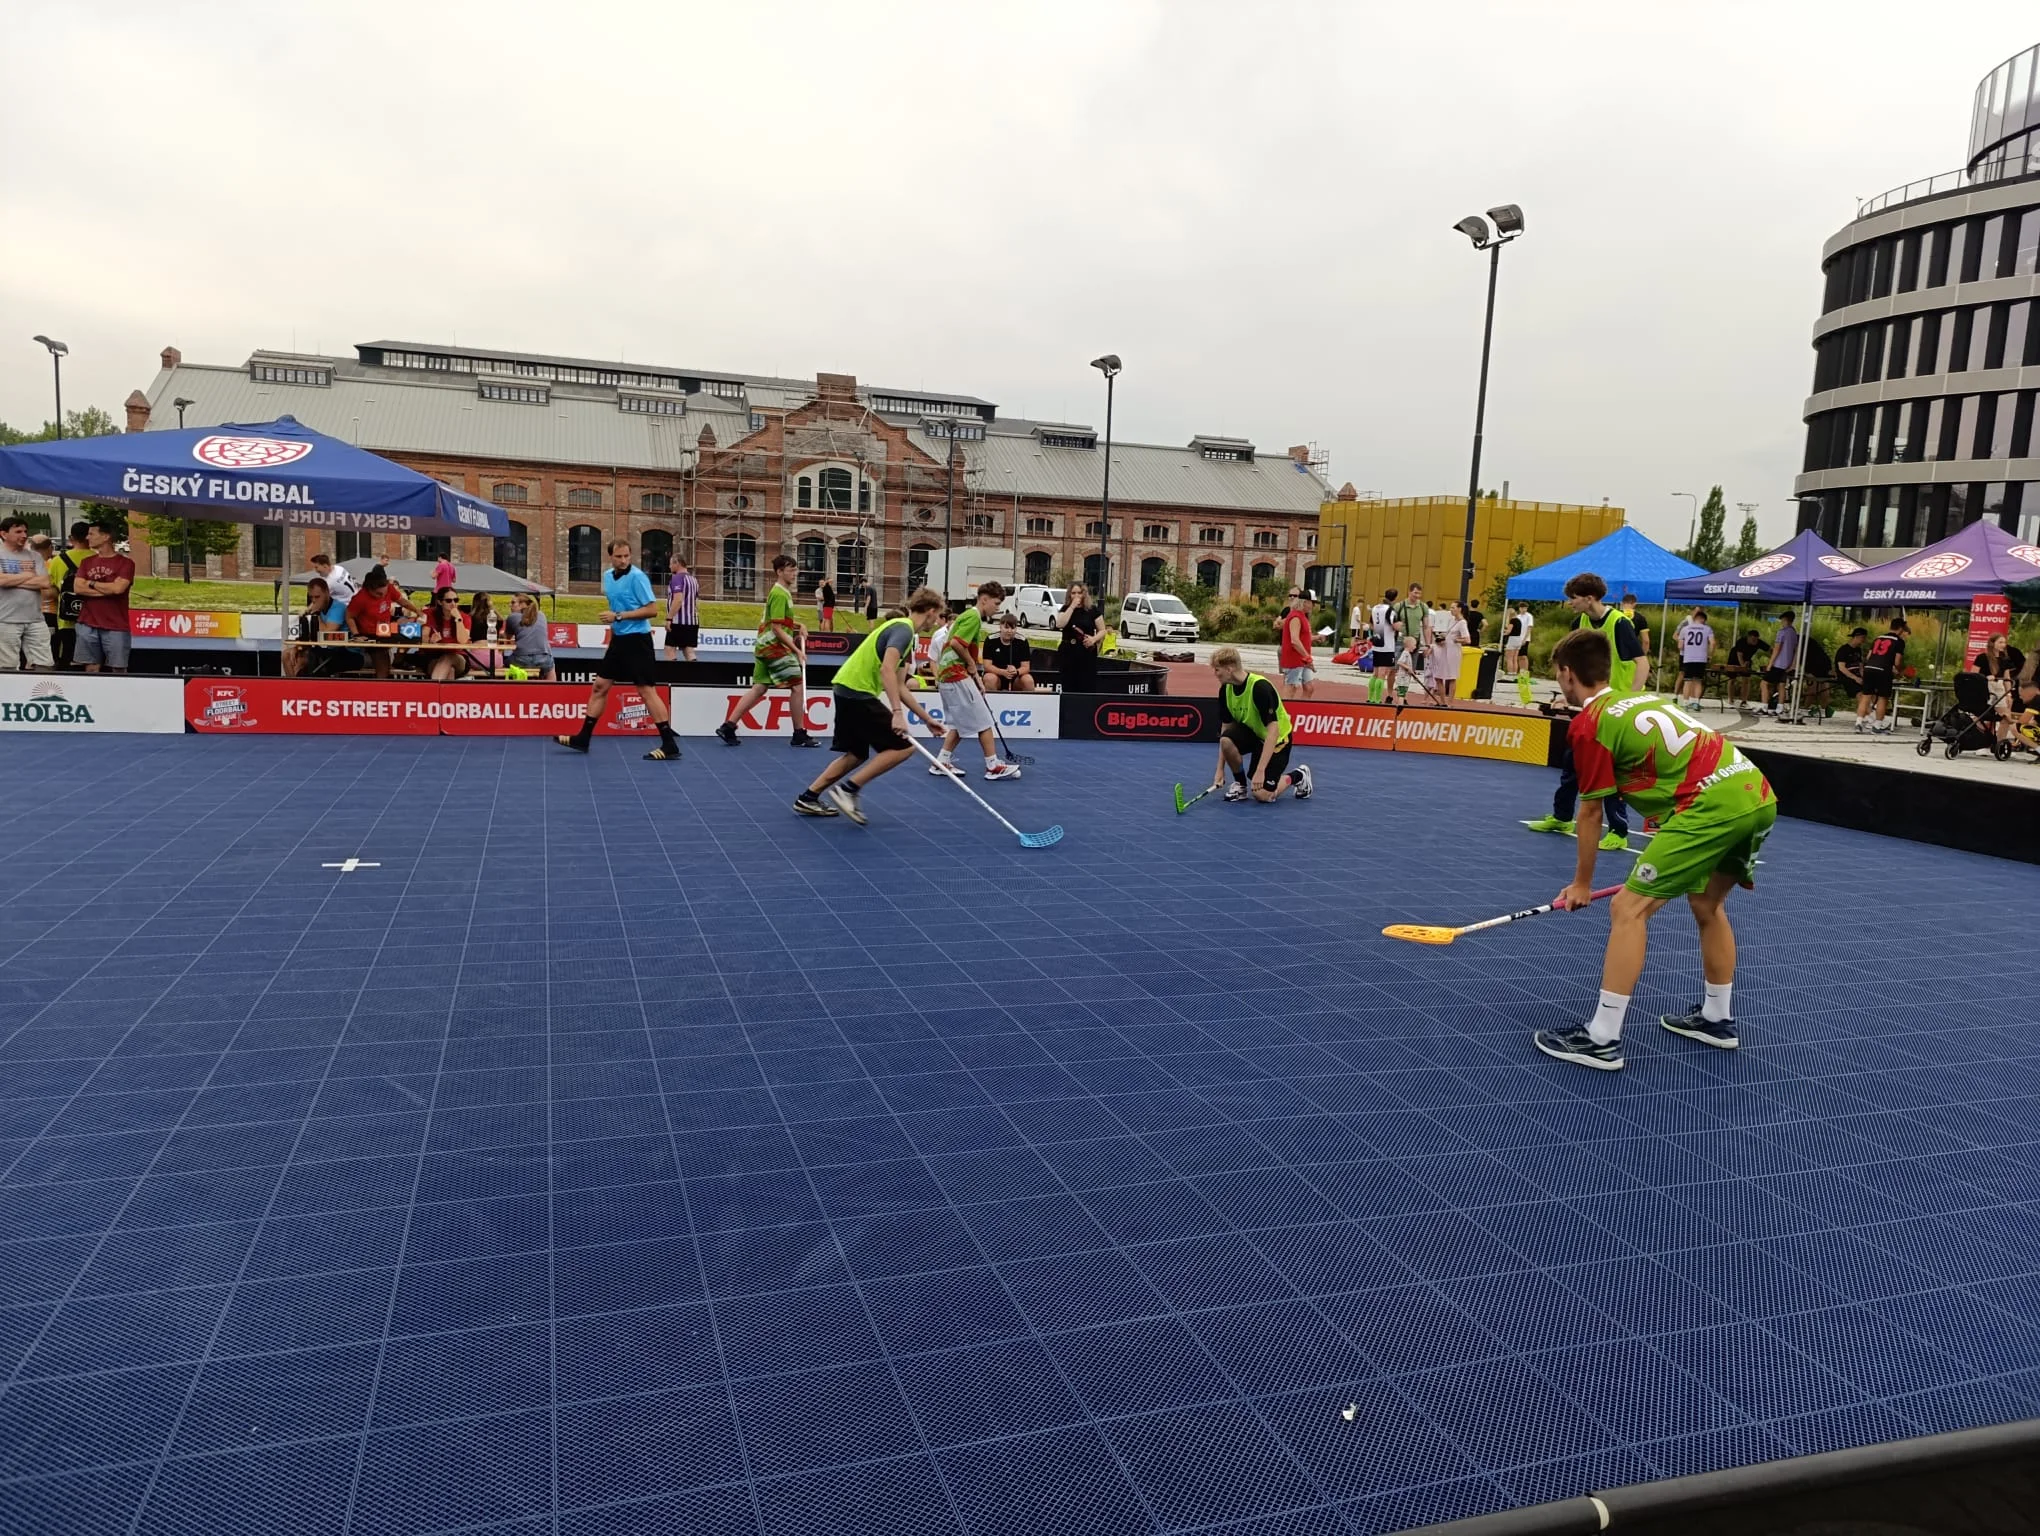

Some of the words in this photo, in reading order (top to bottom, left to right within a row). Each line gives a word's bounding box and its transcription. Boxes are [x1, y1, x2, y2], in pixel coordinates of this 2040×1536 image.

[122, 467, 204, 497] ČESKÝ
[208, 479, 315, 505] FLORBAL
[1703, 582, 1728, 594] ČESKÝ
[1727, 584, 1759, 594] FLORBAL
[1863, 587, 1895, 599] ČESKÝ
[1894, 590, 1937, 600] FLORBAL
[1986, 603, 2008, 613] KFC
[806, 639, 844, 649] igBoard
[1687, 631, 1703, 646] 20
[1872, 639, 1892, 656] 13
[561, 672, 598, 682] UHE
[1128, 683, 1150, 694] UHER
[1, 702, 94, 723] HOLBA
[206, 705, 245, 716] FLOORBALL
[282, 699, 321, 716] KFC
[327, 700, 401, 718] STREET
[405, 702, 515, 719] FLOORBALL
[519, 703, 587, 719] LEAGUE
[725, 695, 832, 731] KFC
[1107, 711, 1189, 730] BigBoard
[1293, 714, 1354, 736] POWER
[1355, 717, 1394, 739] LIKE
[1394, 720, 1463, 742] WOMEN
[1463, 724, 1524, 749] POWER
